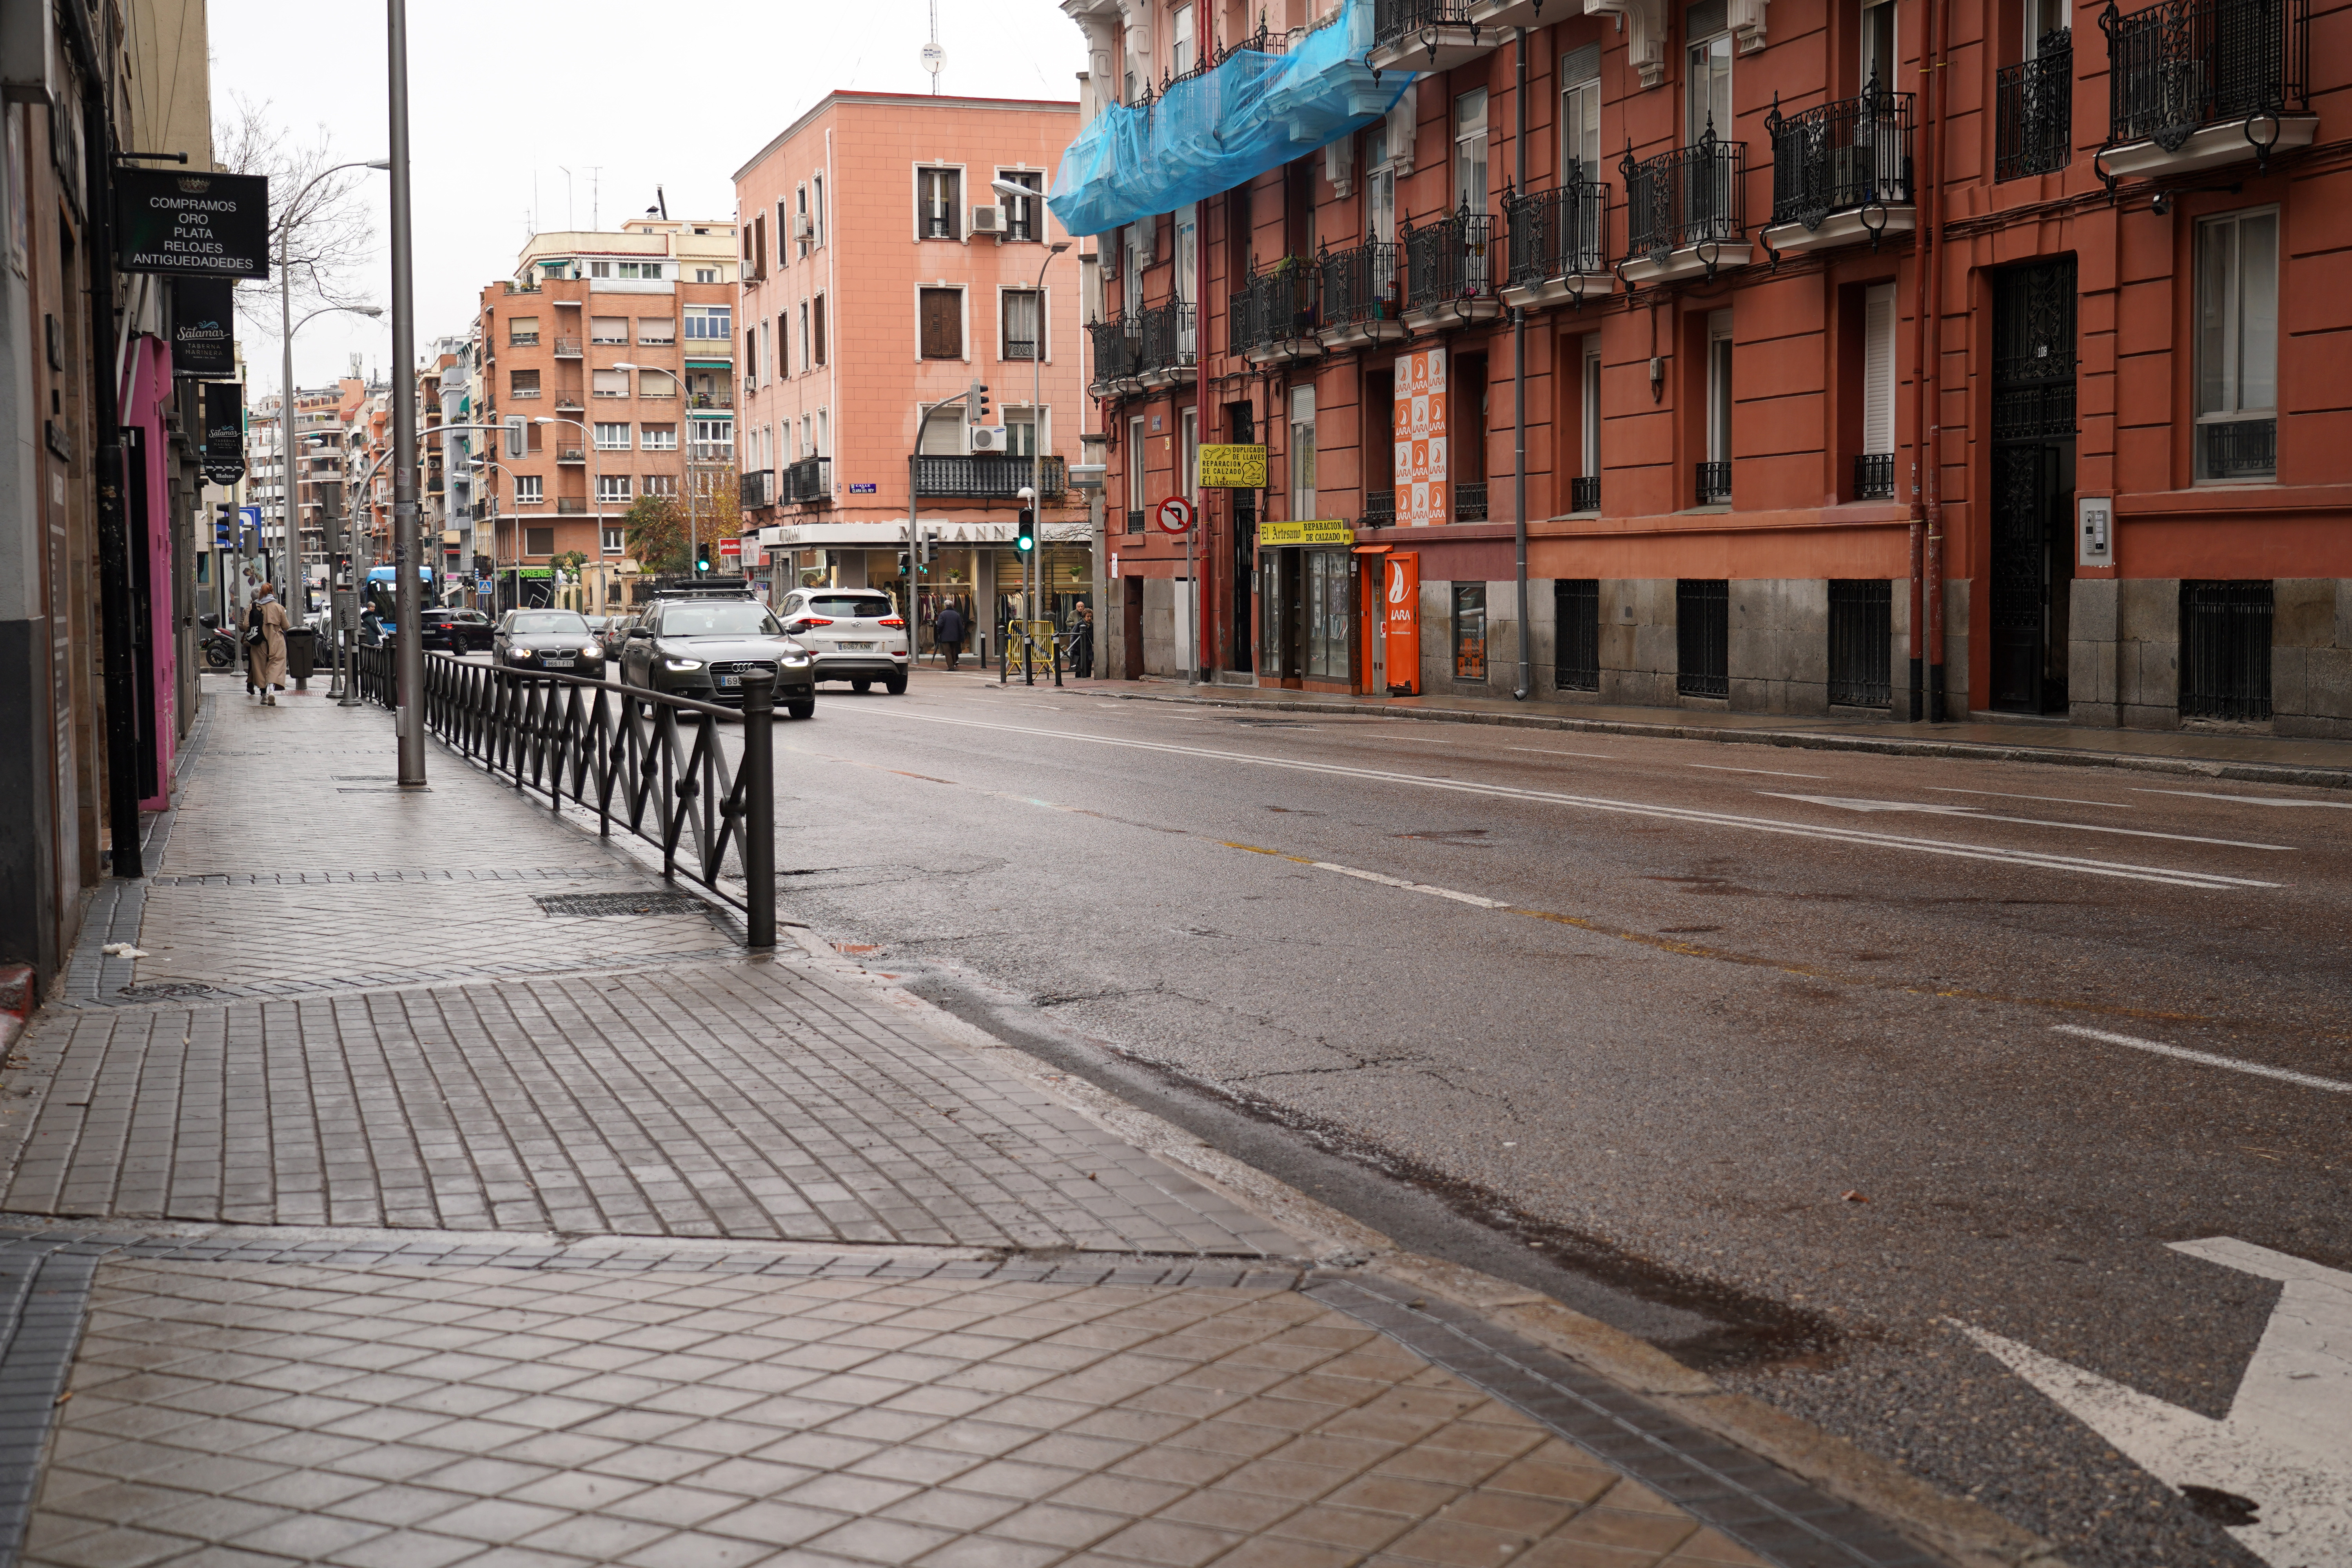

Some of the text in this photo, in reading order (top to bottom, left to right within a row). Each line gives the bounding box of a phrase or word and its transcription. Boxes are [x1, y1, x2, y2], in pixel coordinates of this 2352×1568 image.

[150, 197, 236, 212] COMPRAMOS
[179, 213, 208, 225] ORO
[174, 227, 214, 239] PLATA
[164, 241, 223, 254] RELOJES
[133, 253, 254, 269] ANTIGUEDADEDES
[177, 327, 230, 341] Salamar
[1412, 379, 1428, 390] LARA
[1429, 376, 1445, 387] LARA
[1396, 383, 1411, 393] LARA
[1396, 426, 1411, 436] LARA
[1412, 423, 1428, 434] LARA
[1429, 421, 1445, 431] LARA
[209, 429, 241, 438] Salamar
[1397, 468, 1411, 477] LARA
[1412, 467, 1428, 476] LARA
[1429, 465, 1445, 474] LARA
[1202, 475, 1212, 486] El
[1397, 511, 1411, 521] LARA
[1412, 510, 1428, 519] LARA
[1429, 509, 1445, 518] LARA
[1261, 522, 1341, 541] El Artesano REPARACION
[1315, 533, 1340, 541] CALZADO
[376, 583, 380, 591] 1
[1391, 609, 1410, 620] LARA
